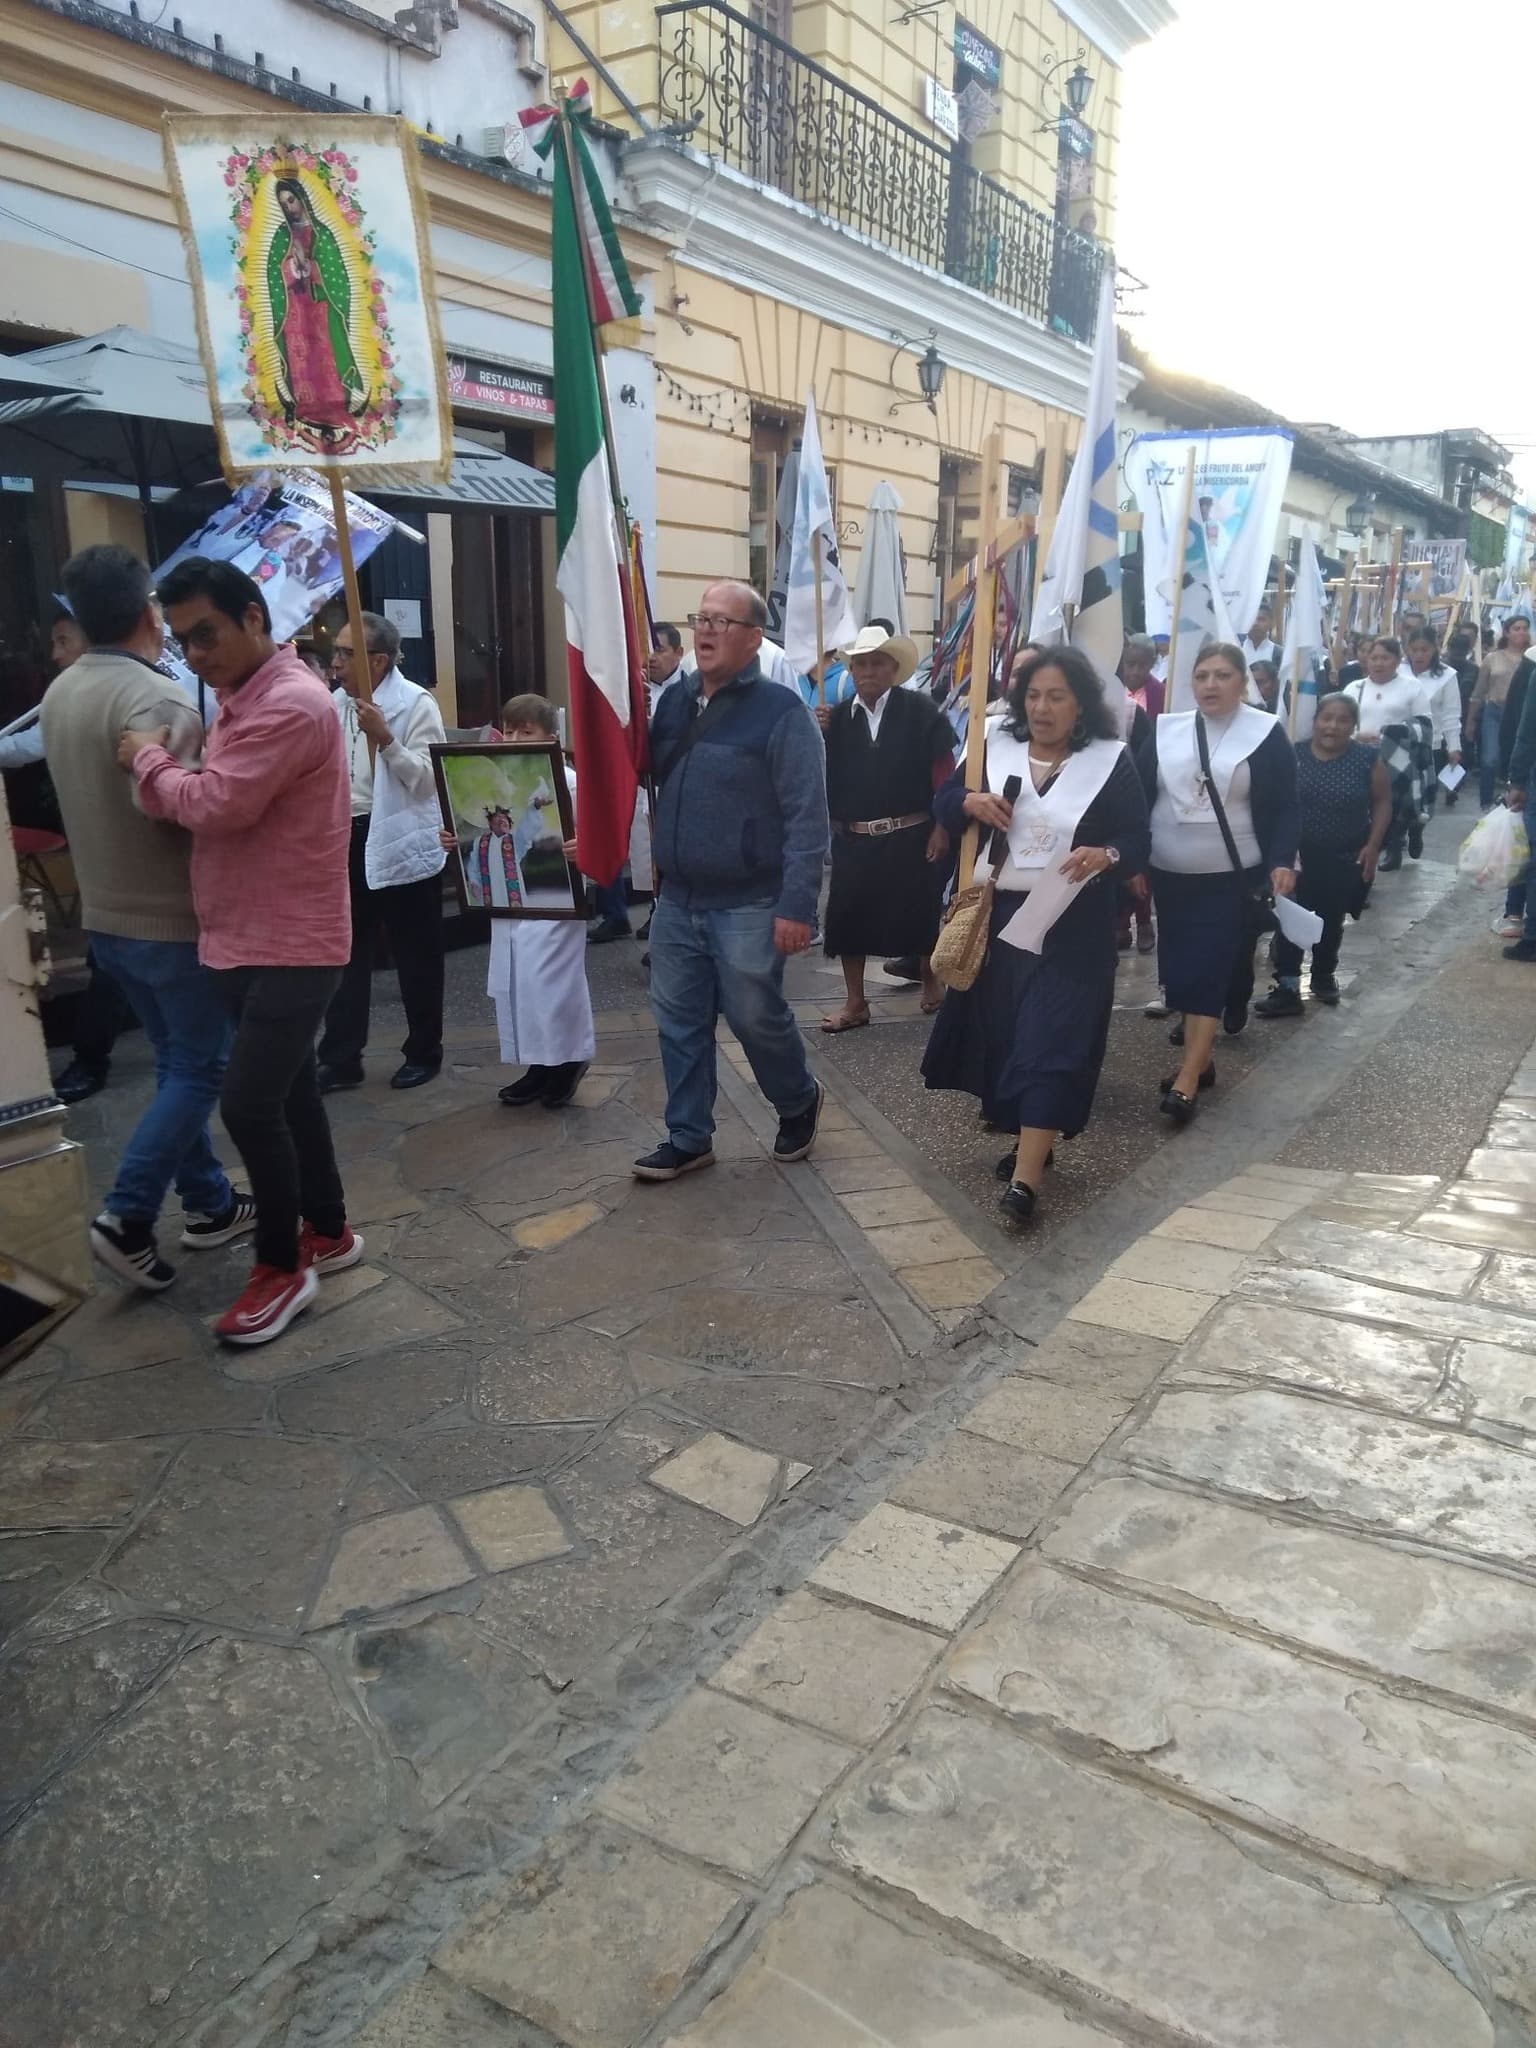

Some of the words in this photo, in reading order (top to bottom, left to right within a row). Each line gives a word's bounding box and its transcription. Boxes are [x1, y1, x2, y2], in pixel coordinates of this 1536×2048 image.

[480, 371, 544, 395] RESTAURANTE
[476, 385, 505, 402] VINOS
[509, 393, 518, 404] &
[518, 394, 548, 410] TAPAS
[283, 488, 297, 502] LA
